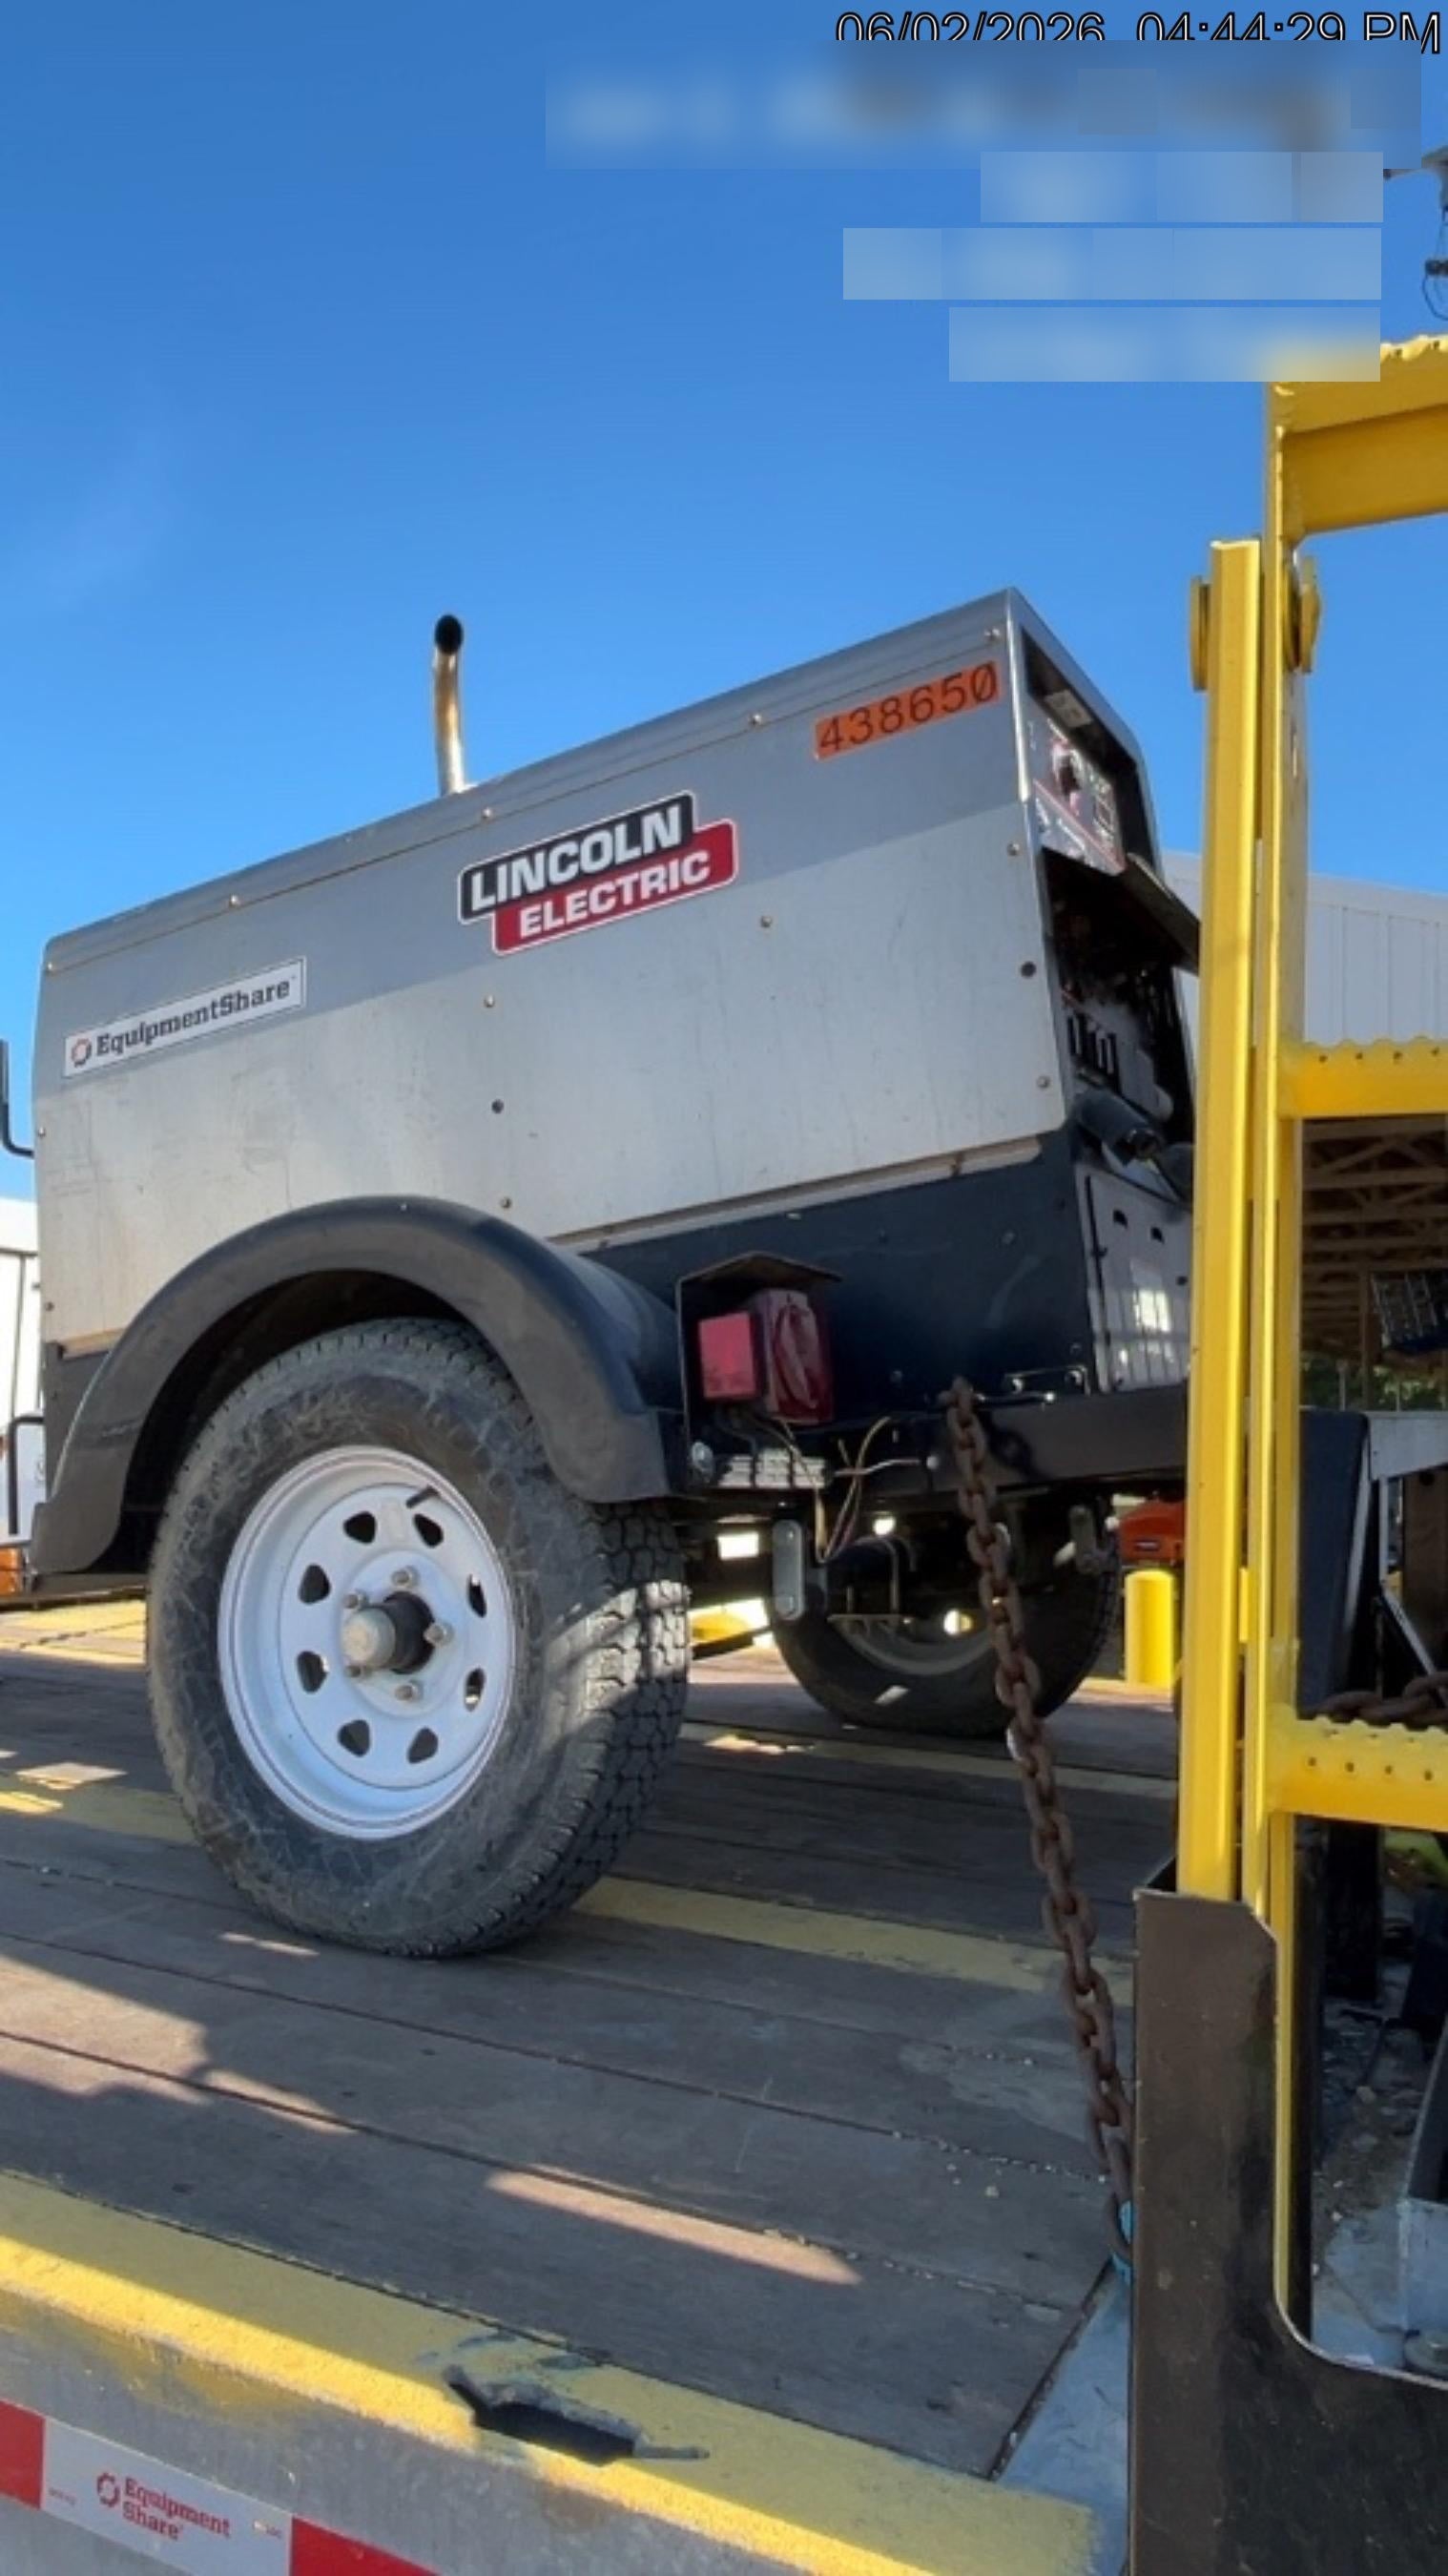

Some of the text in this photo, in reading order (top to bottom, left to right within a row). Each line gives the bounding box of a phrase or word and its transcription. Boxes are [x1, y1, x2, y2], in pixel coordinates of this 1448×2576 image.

[820, 660, 998, 751] 438650
[471, 804, 682, 911] LINCOLN
[520, 850, 711, 939] ELECTRIC
[96, 979, 290, 1056] EquipmentShare
[122, 2501, 179, 2540] Share
[124, 2477, 231, 2538] Equipment
